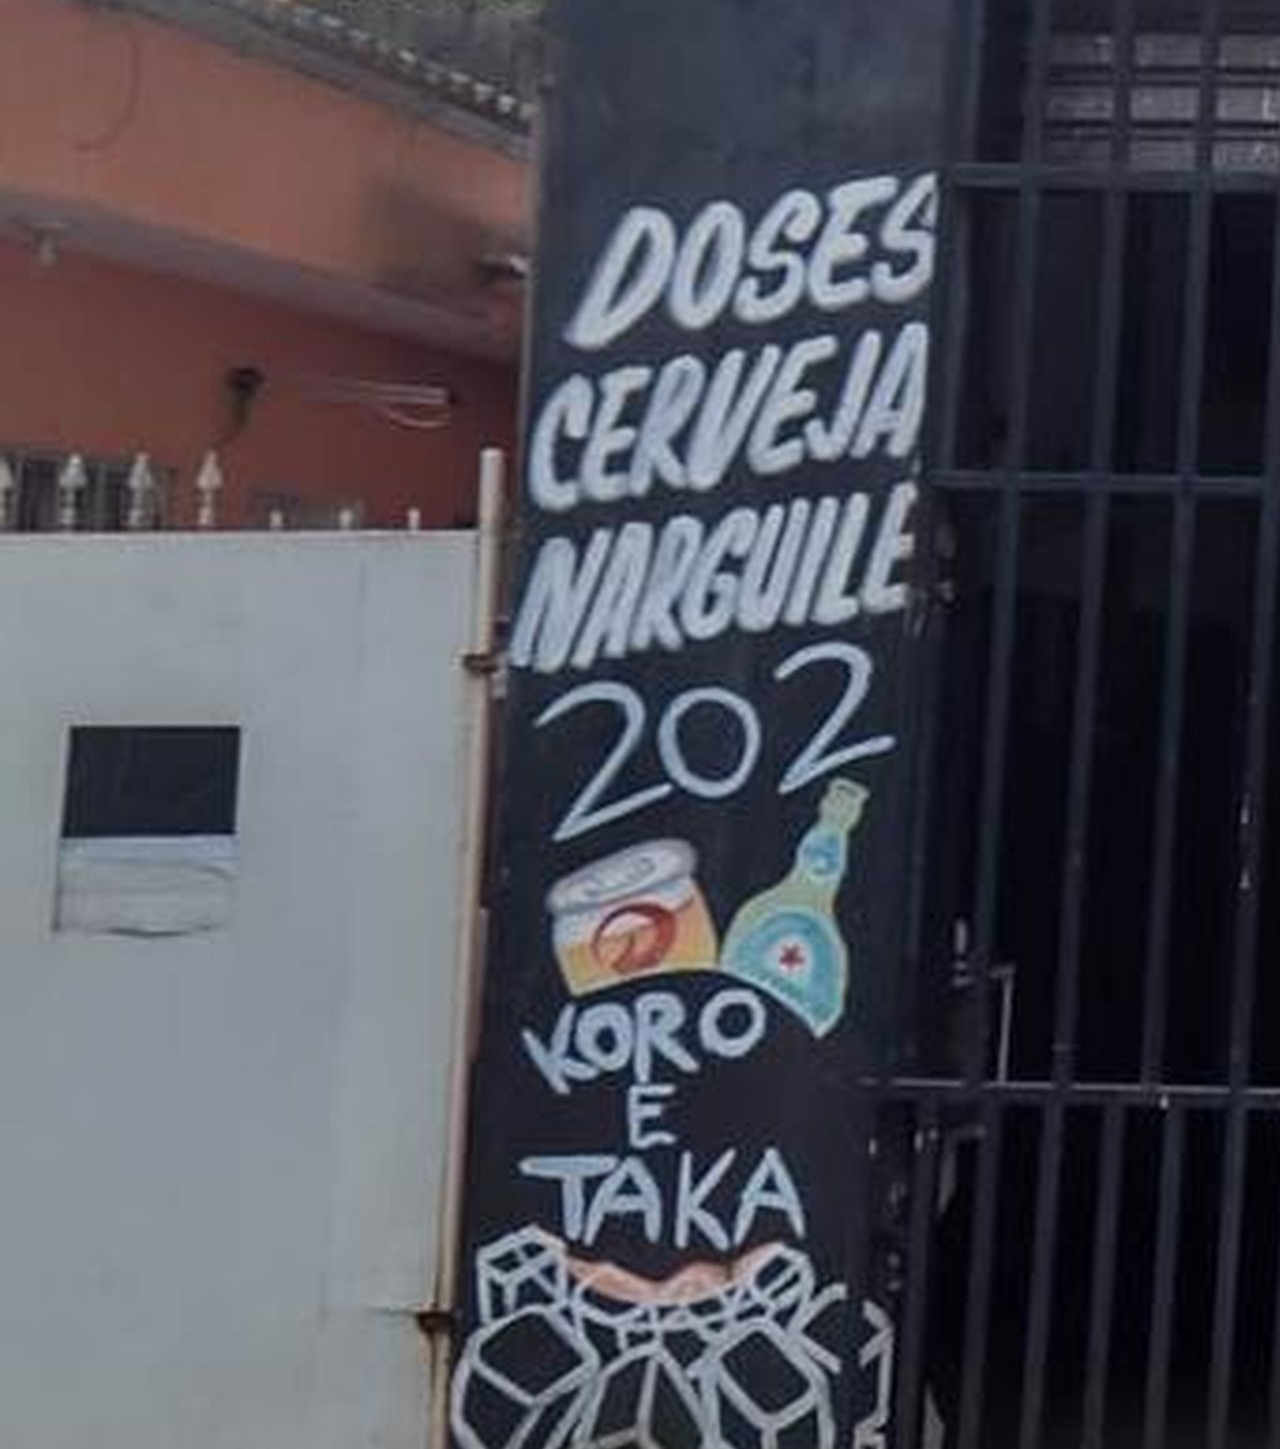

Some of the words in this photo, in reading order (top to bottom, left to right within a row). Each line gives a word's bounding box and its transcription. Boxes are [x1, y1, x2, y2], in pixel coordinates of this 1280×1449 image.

[564, 170, 939, 349] DOSES
[528, 322, 930, 510] CERVEJA
[508, 481, 918, 674] NARGUILE
[533, 641, 897, 842] 202
[521, 988, 767, 1093] KORO
[628, 1083, 675, 1146] E
[517, 1147, 806, 1250] TAKA
